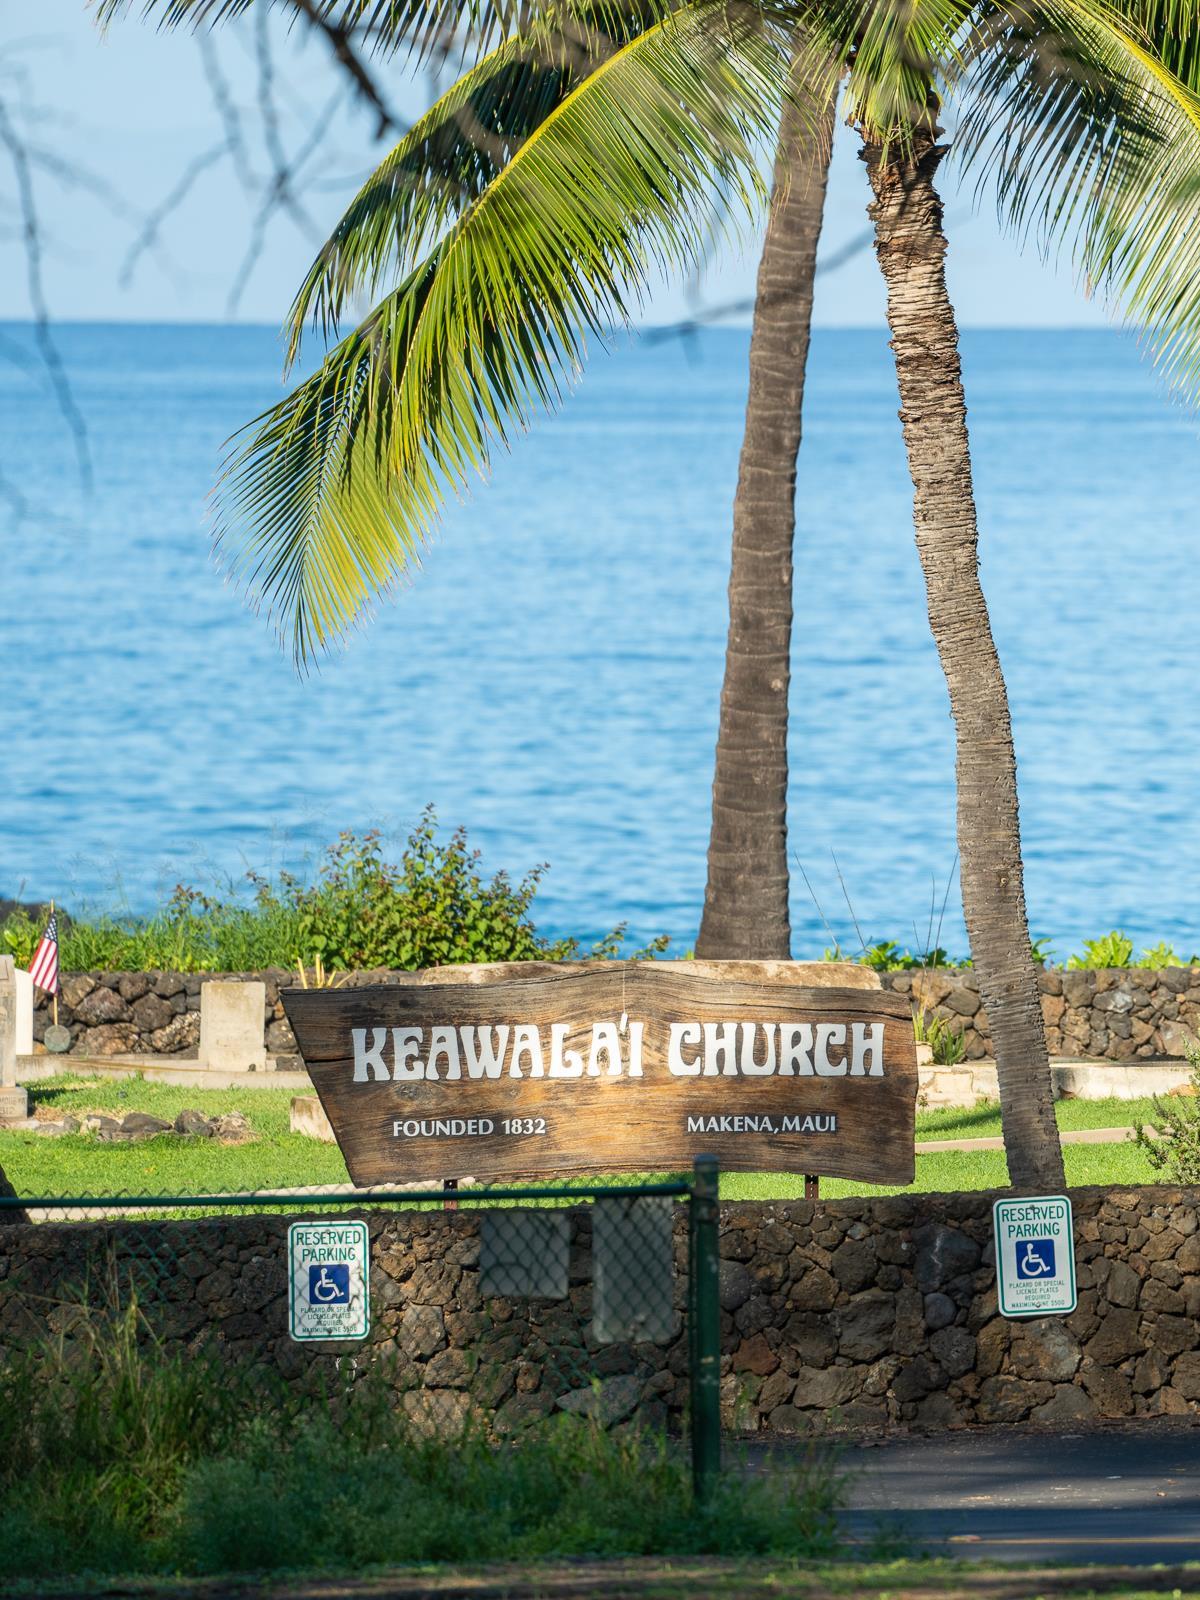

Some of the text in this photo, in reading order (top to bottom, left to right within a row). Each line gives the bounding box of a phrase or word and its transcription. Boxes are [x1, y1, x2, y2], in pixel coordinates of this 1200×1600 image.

[668, 1022, 885, 1077] CHURCH
[393, 1118, 546, 1137] FOUNDED 1832
[1001, 1205, 1065, 1223] RESERVED
[296, 1230, 361, 1246] RESERVED
[1008, 1222, 1060, 1238] PARKING
[302, 1247, 356, 1262] PARKING
[1009, 1281, 1033, 1289] PLACARD
